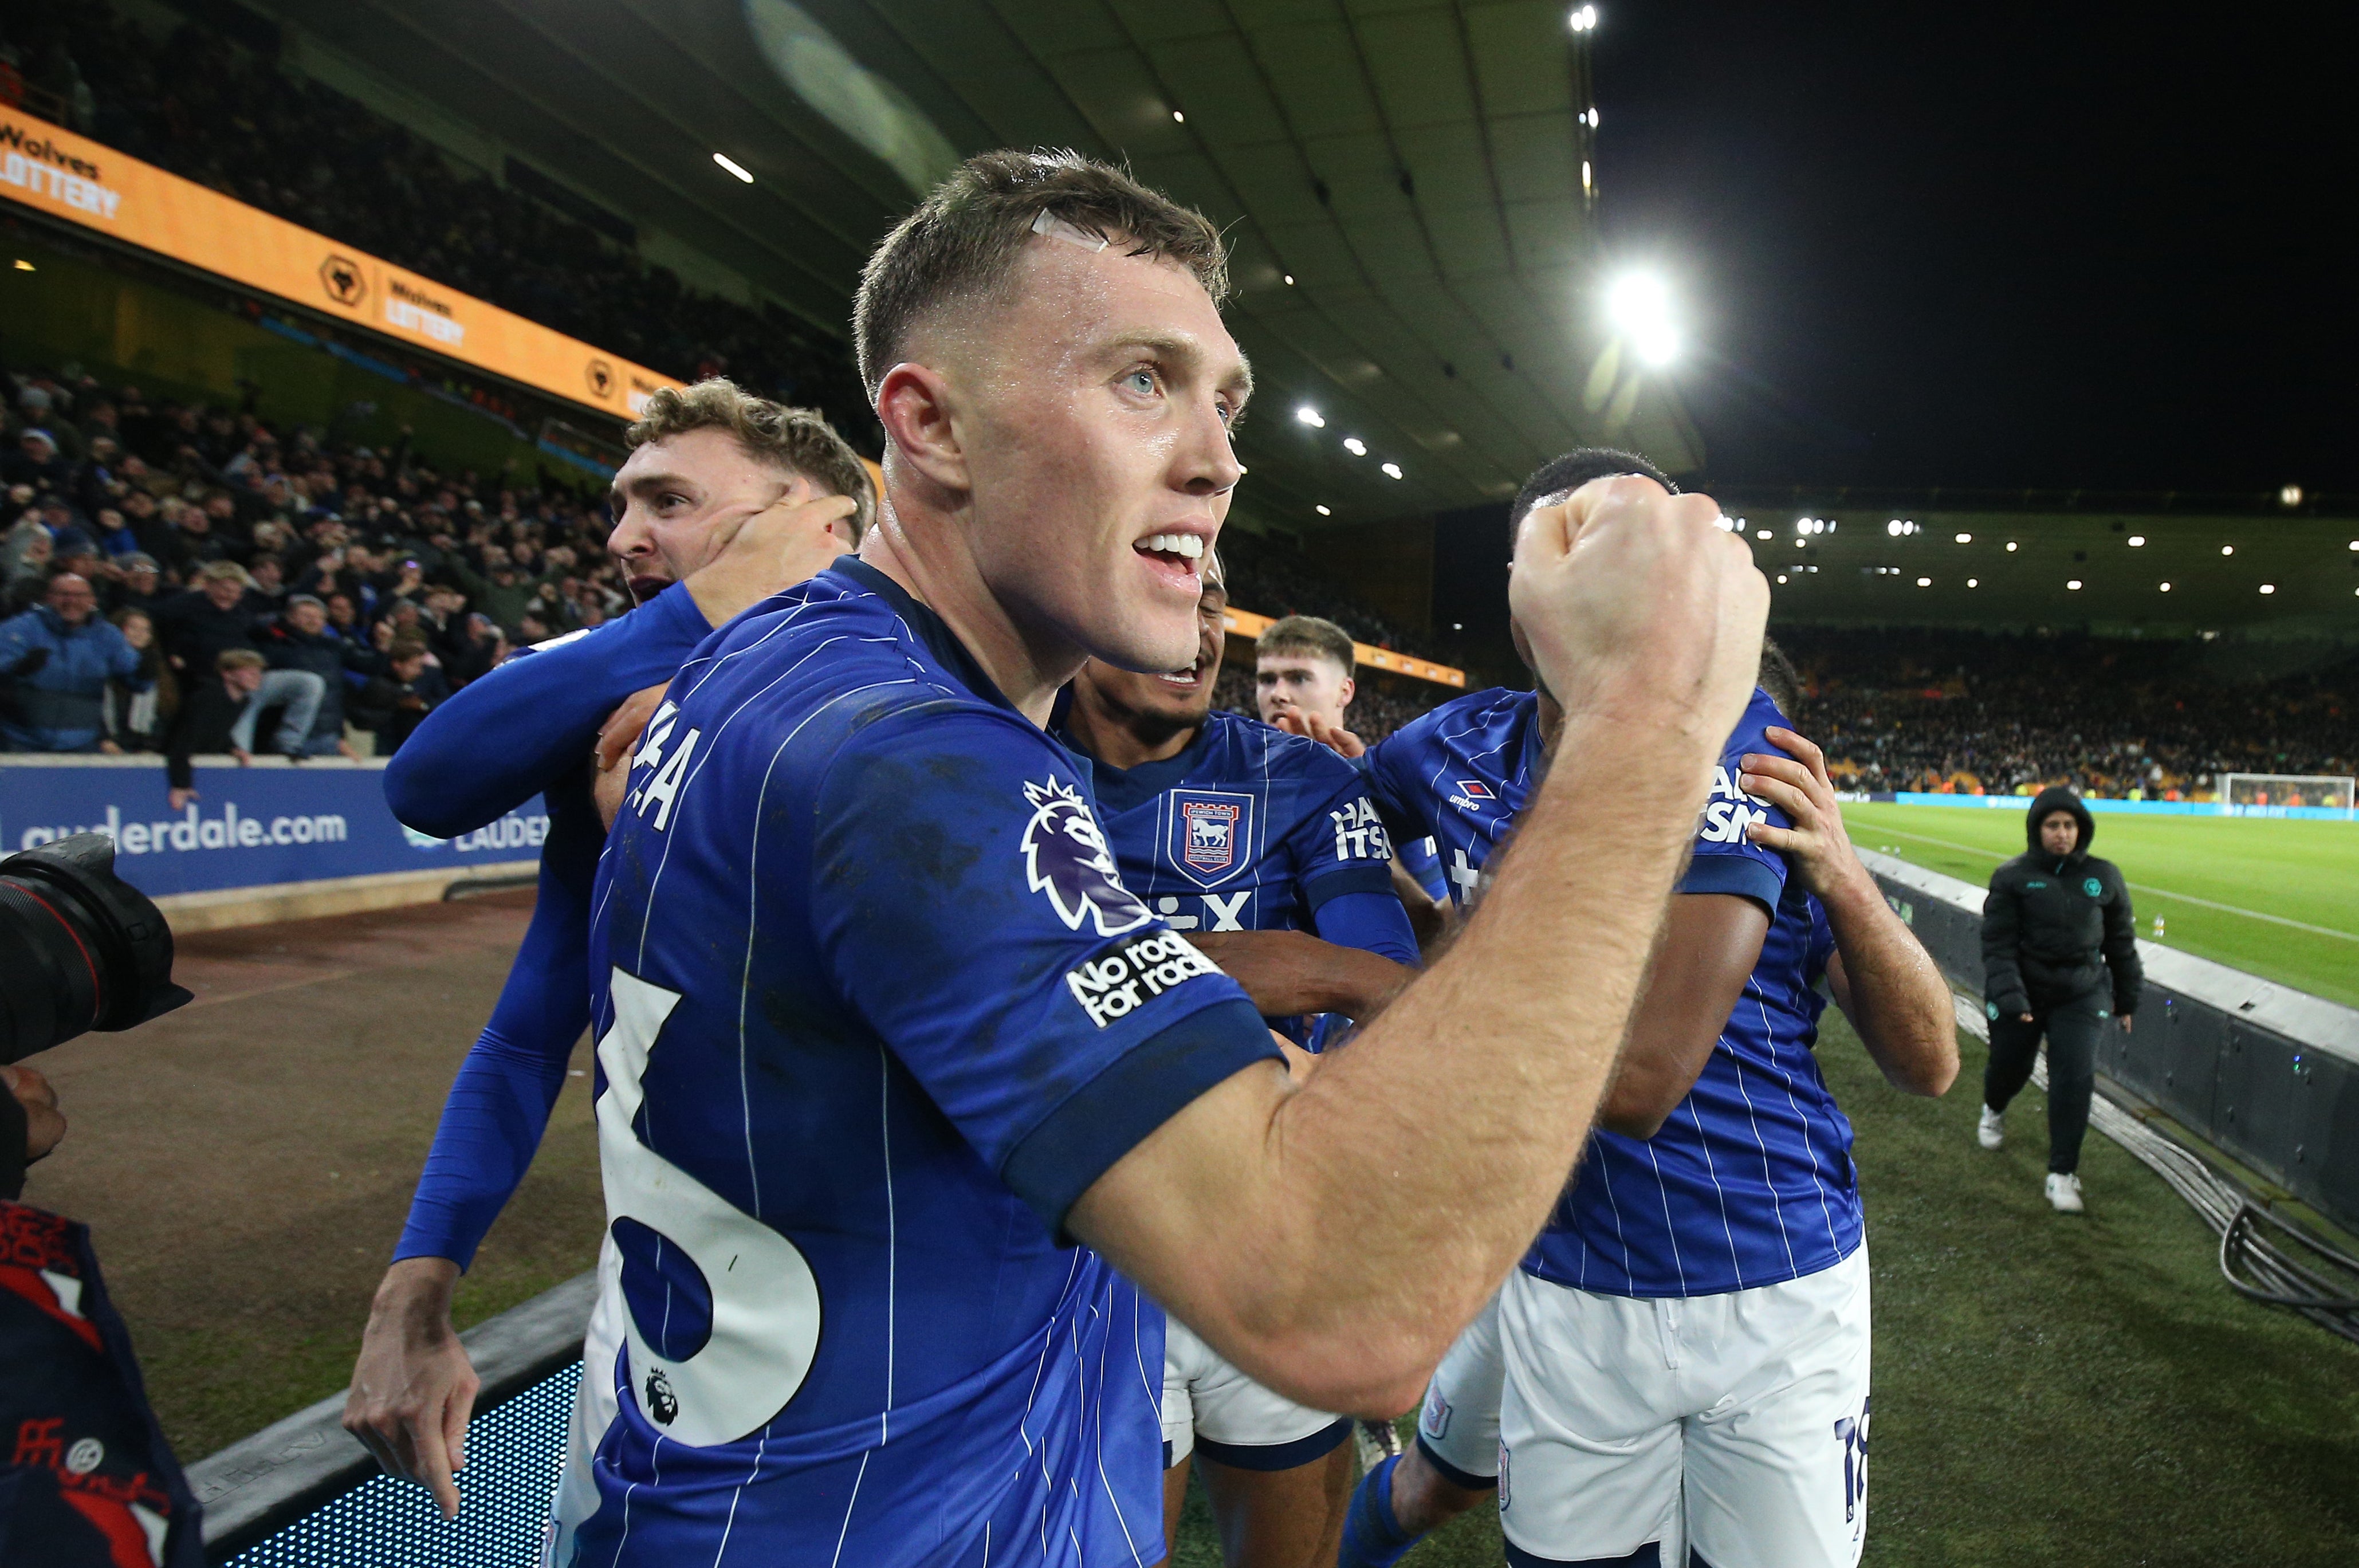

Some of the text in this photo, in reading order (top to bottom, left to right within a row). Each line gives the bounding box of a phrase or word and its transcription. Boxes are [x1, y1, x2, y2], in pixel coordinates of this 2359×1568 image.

[0, 150, 120, 219] OTTERY
[1329, 796, 1382, 835] HA
[1449, 794, 1480, 811] umbro
[0, 801, 347, 861] aderdale.com
[455, 815, 550, 852] LAUDE
[1066, 929, 1200, 1005] No roo
[1084, 978, 1142, 1028] for
